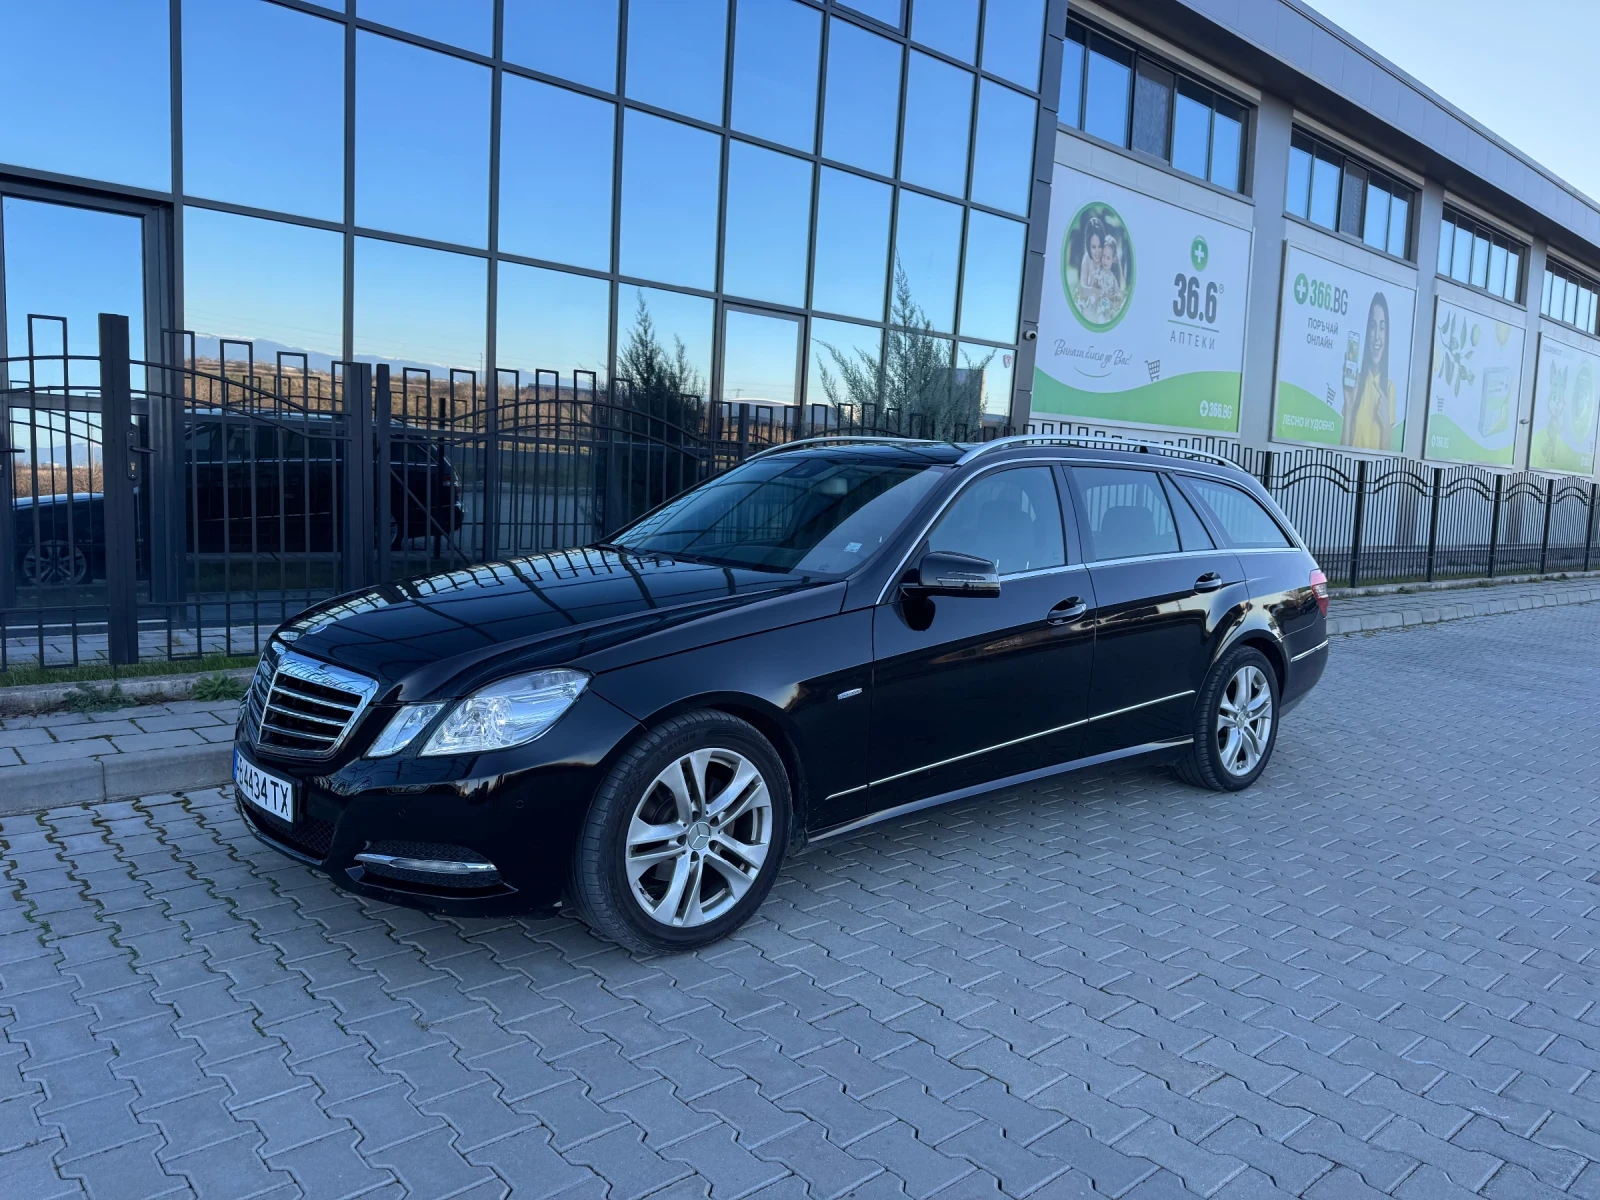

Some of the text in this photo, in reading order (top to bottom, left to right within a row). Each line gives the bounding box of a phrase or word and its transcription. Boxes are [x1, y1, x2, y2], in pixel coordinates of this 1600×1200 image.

[1173, 272, 1218, 324] 36.6
[1309, 279, 1349, 316] 366.BG
[1307, 317, 1339, 336] ПОРЪЧАЙ
[1169, 330, 1216, 350] АПТЕКИ
[1306, 333, 1334, 350] ОНЛАЙН
[1209, 402, 1233, 419] 366.BG
[1282, 413, 1335, 431] ЛЕСНО И УДОБНО
